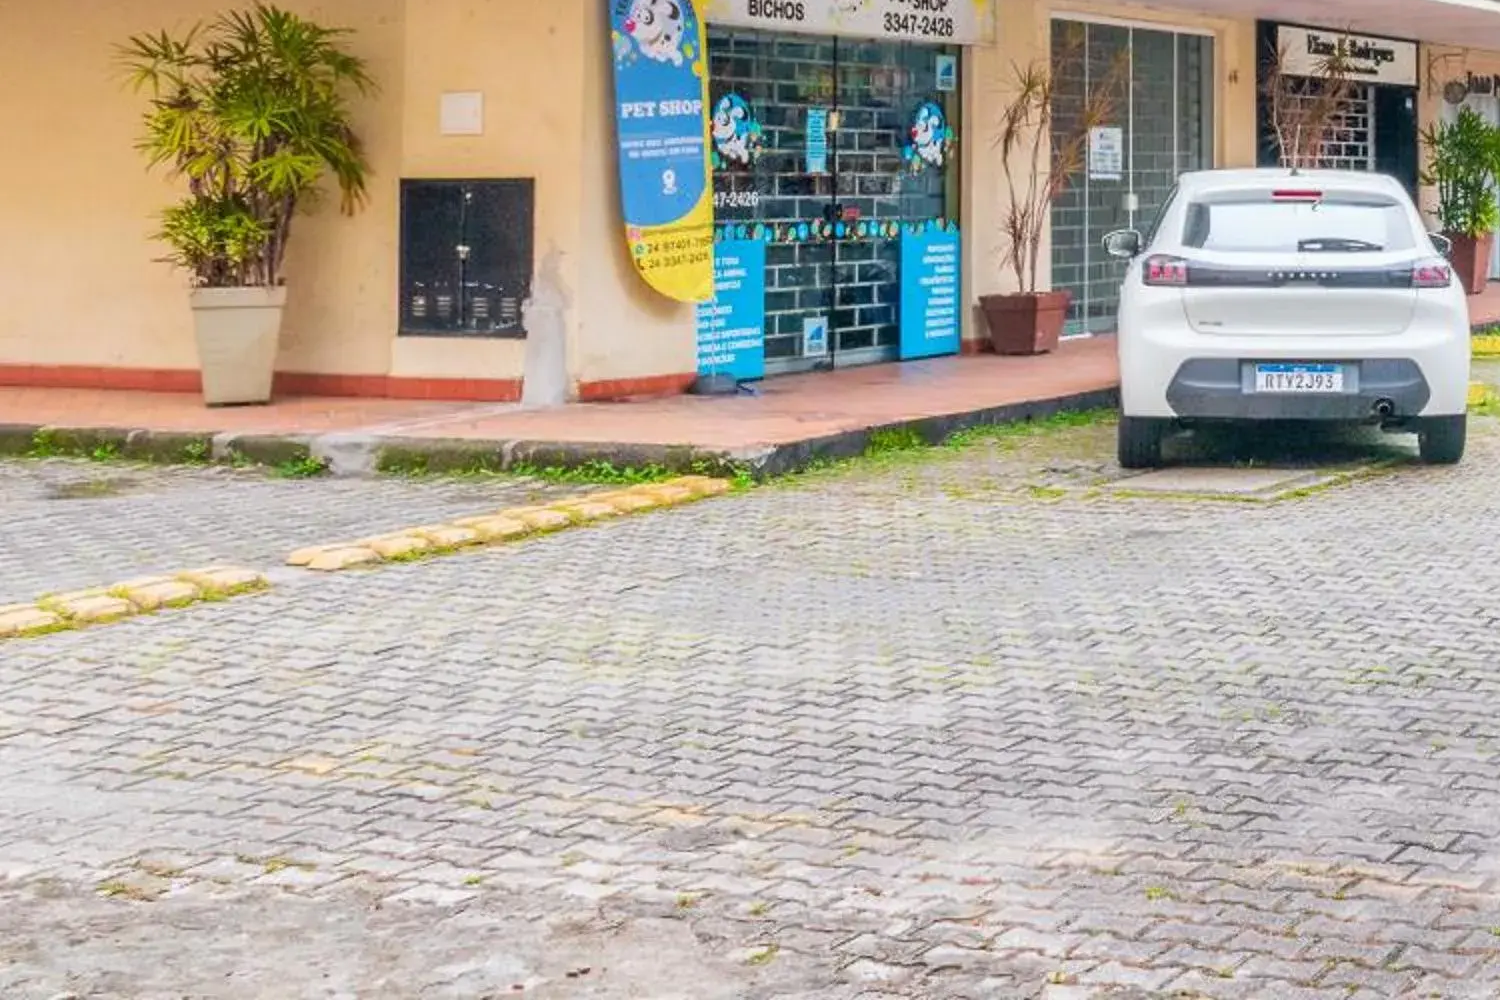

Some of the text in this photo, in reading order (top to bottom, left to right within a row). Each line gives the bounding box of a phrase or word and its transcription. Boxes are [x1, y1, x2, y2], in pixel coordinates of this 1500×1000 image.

[884, 12, 954, 37] 3347-2426
[621, 99, 702, 119] PET SHOP
